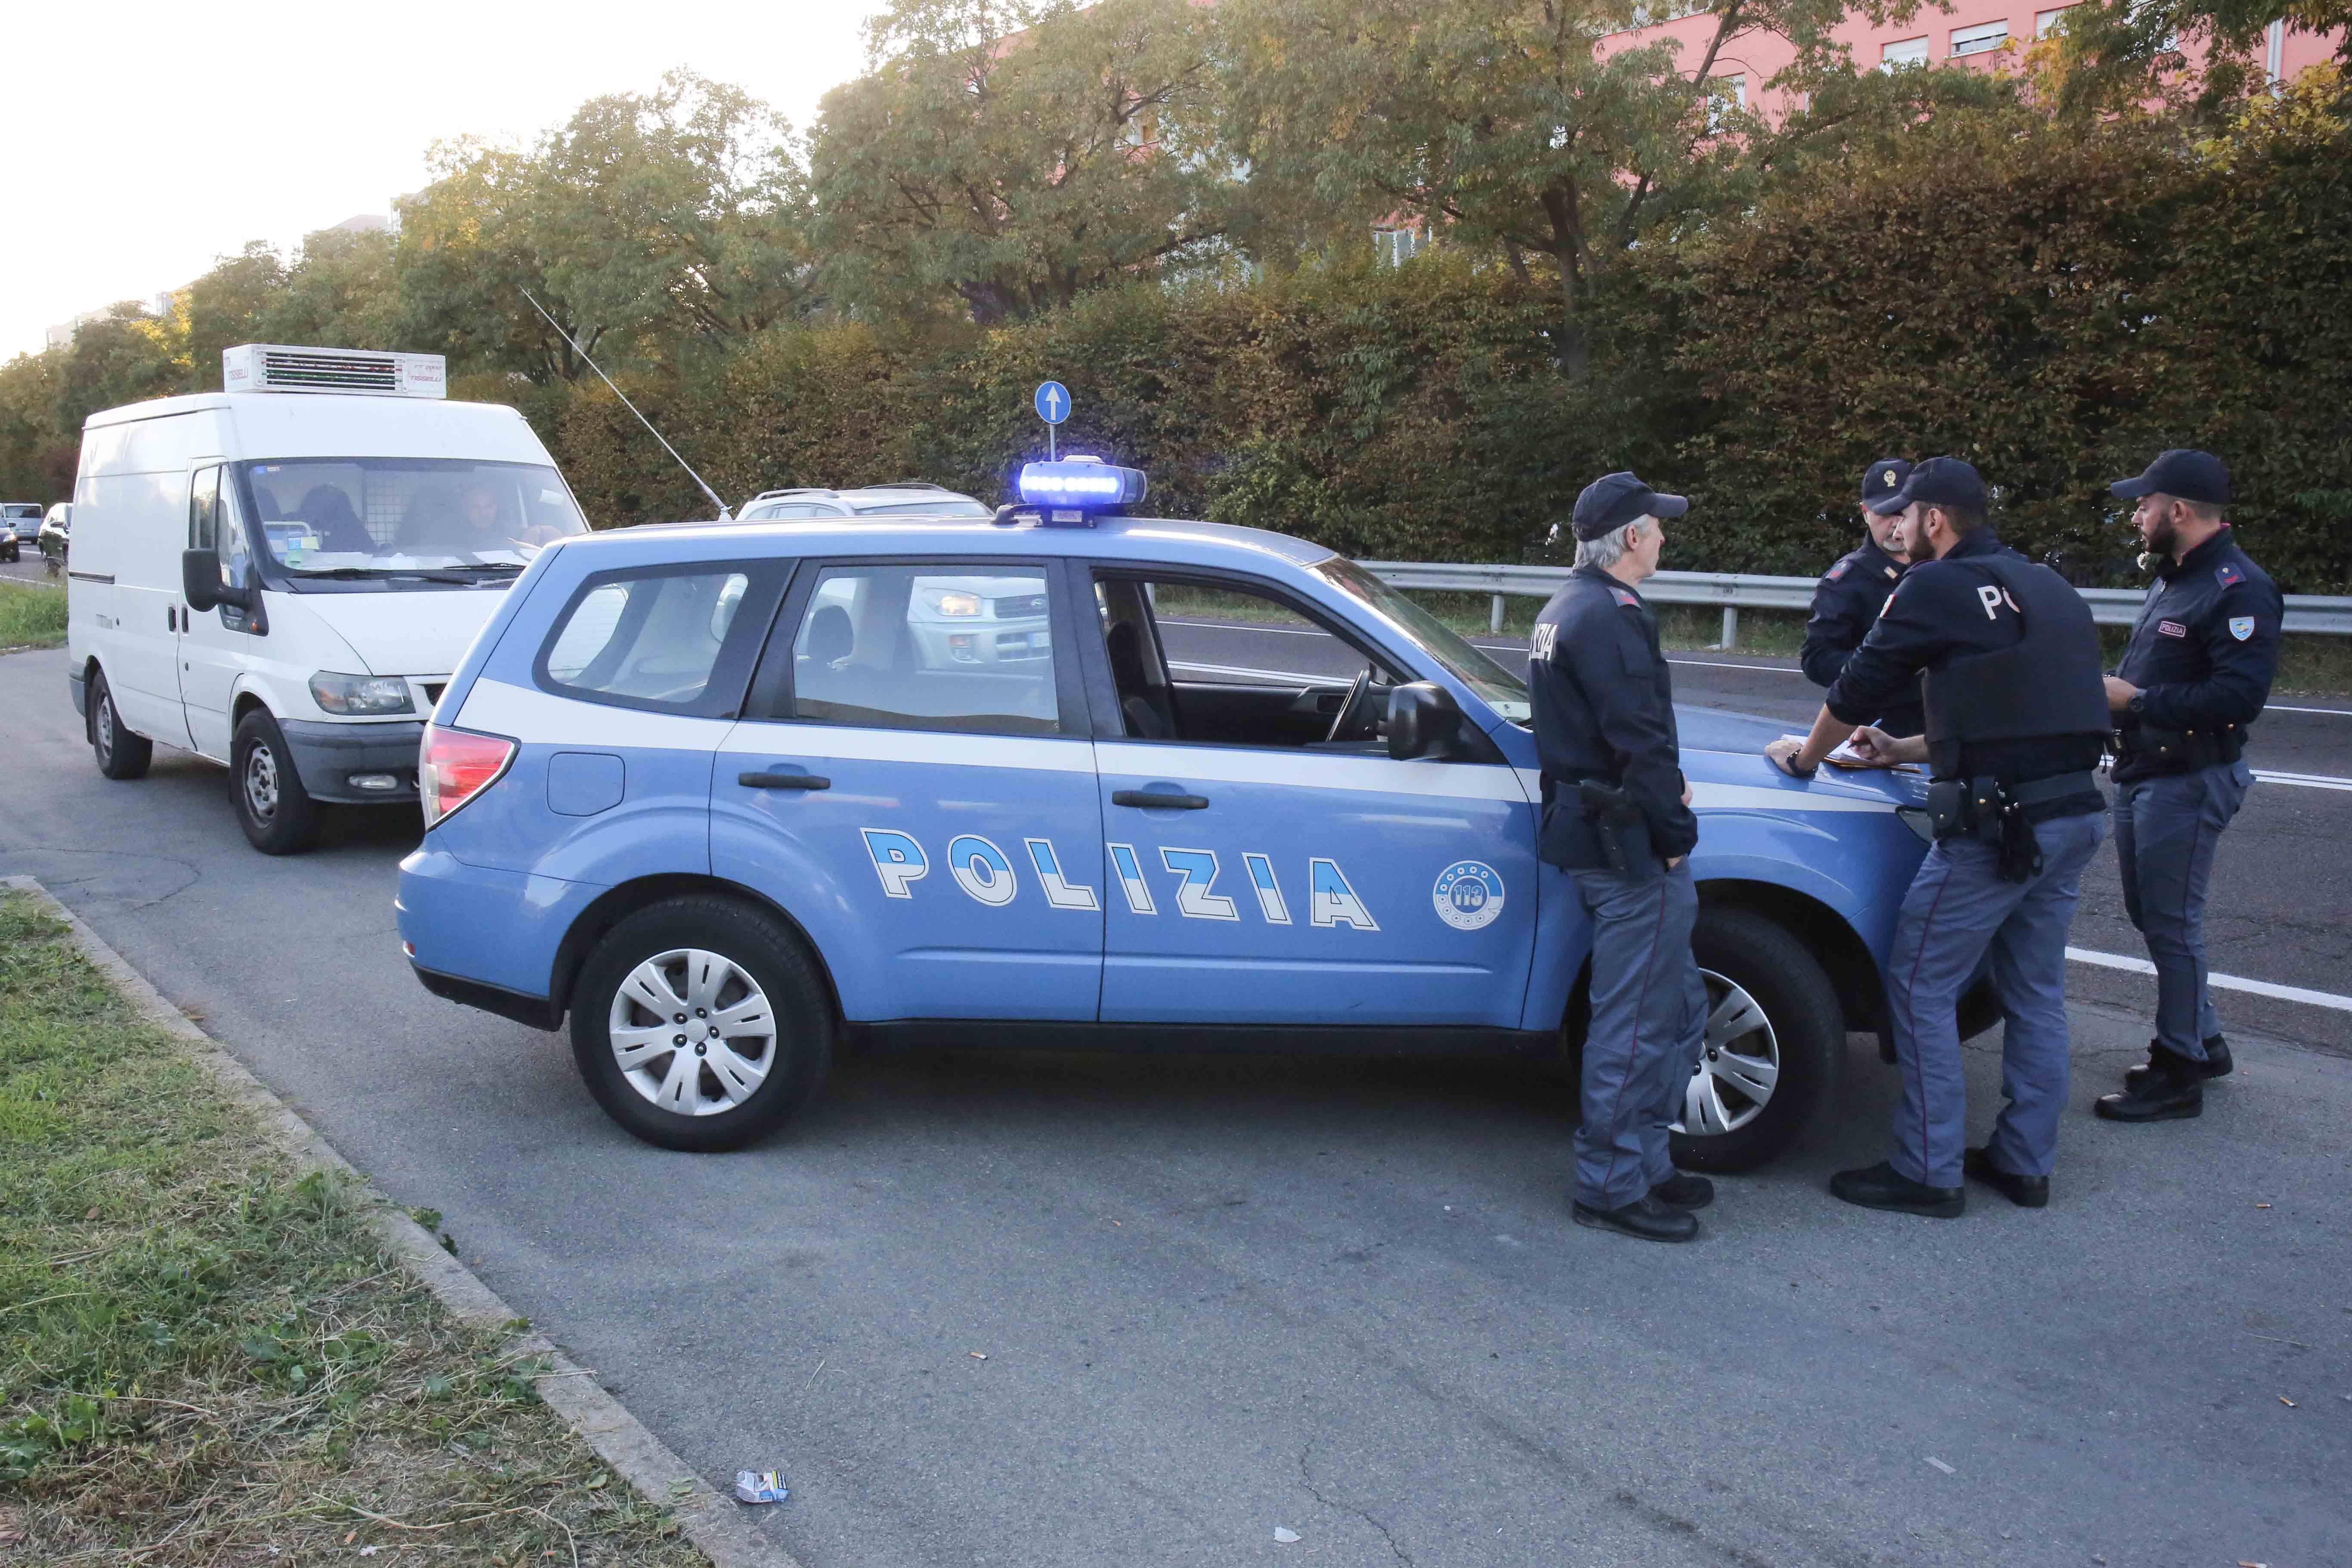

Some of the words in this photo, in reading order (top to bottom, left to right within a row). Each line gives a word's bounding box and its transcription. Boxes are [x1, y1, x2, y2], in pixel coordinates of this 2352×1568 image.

[2161, 623, 2183, 634] POLIZIA
[859, 827, 1381, 932] POLIZIA
[1454, 885, 1483, 906] 113
